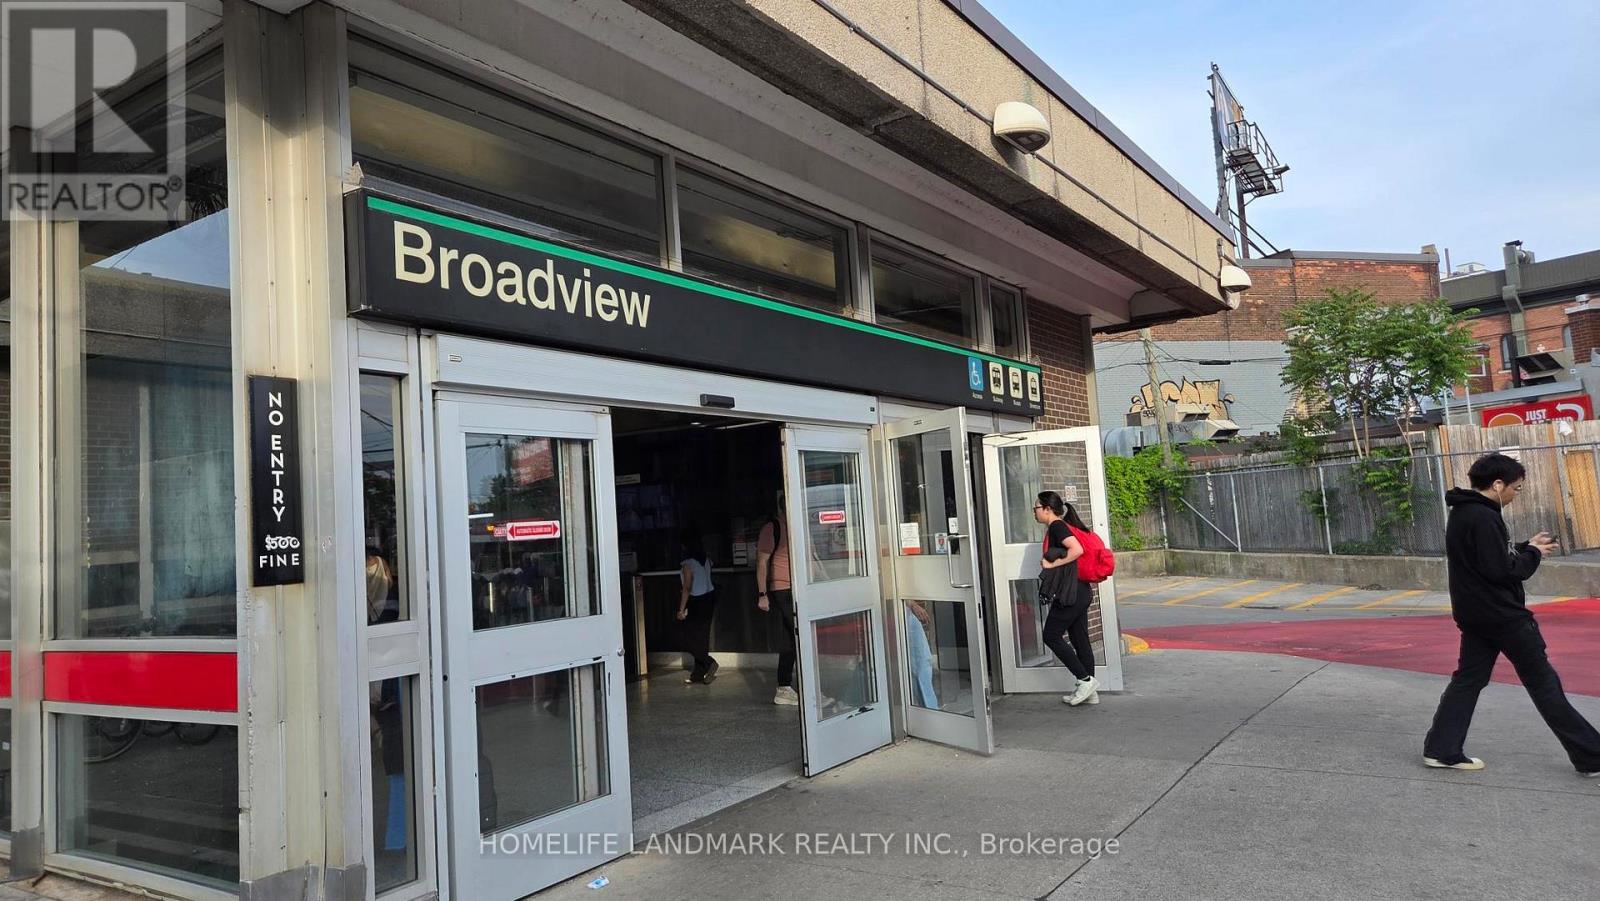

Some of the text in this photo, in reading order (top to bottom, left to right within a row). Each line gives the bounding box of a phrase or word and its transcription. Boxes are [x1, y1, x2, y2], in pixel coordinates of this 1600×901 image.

[394, 220, 651, 328] Broadview
[1525, 409, 1547, 421] JUST
[268, 392, 286, 523] NO ENTRY
[265, 534, 300, 551] $500
[259, 553, 300, 569] FINE
